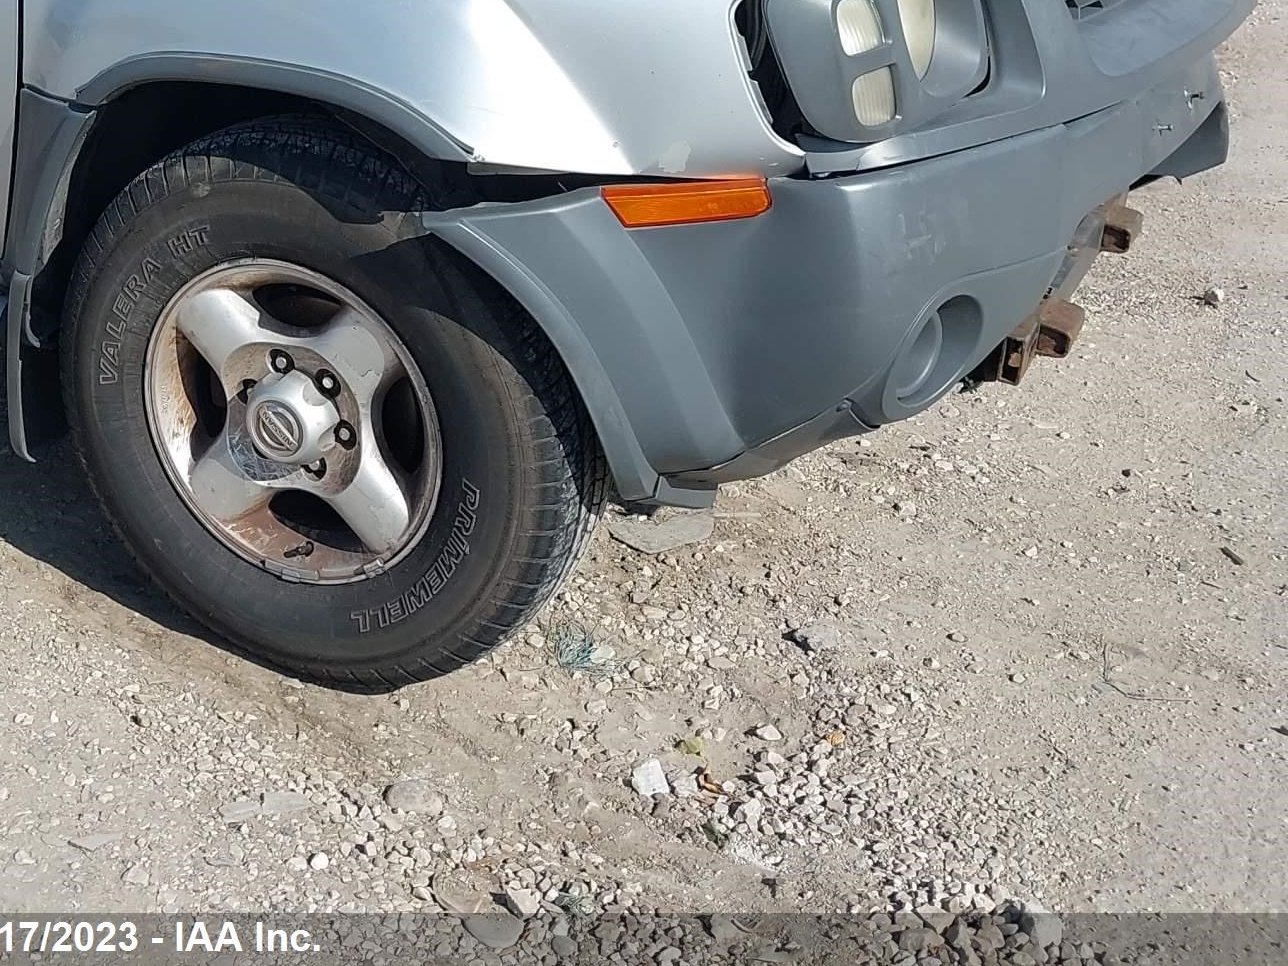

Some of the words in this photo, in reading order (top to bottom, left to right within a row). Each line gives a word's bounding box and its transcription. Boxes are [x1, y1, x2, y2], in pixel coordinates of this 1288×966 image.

[99, 256, 162, 386] VALERA
[166, 225, 211, 258] HT
[262, 411, 296, 448] NISSAN
[350, 479, 481, 634] PRIMEWELL
